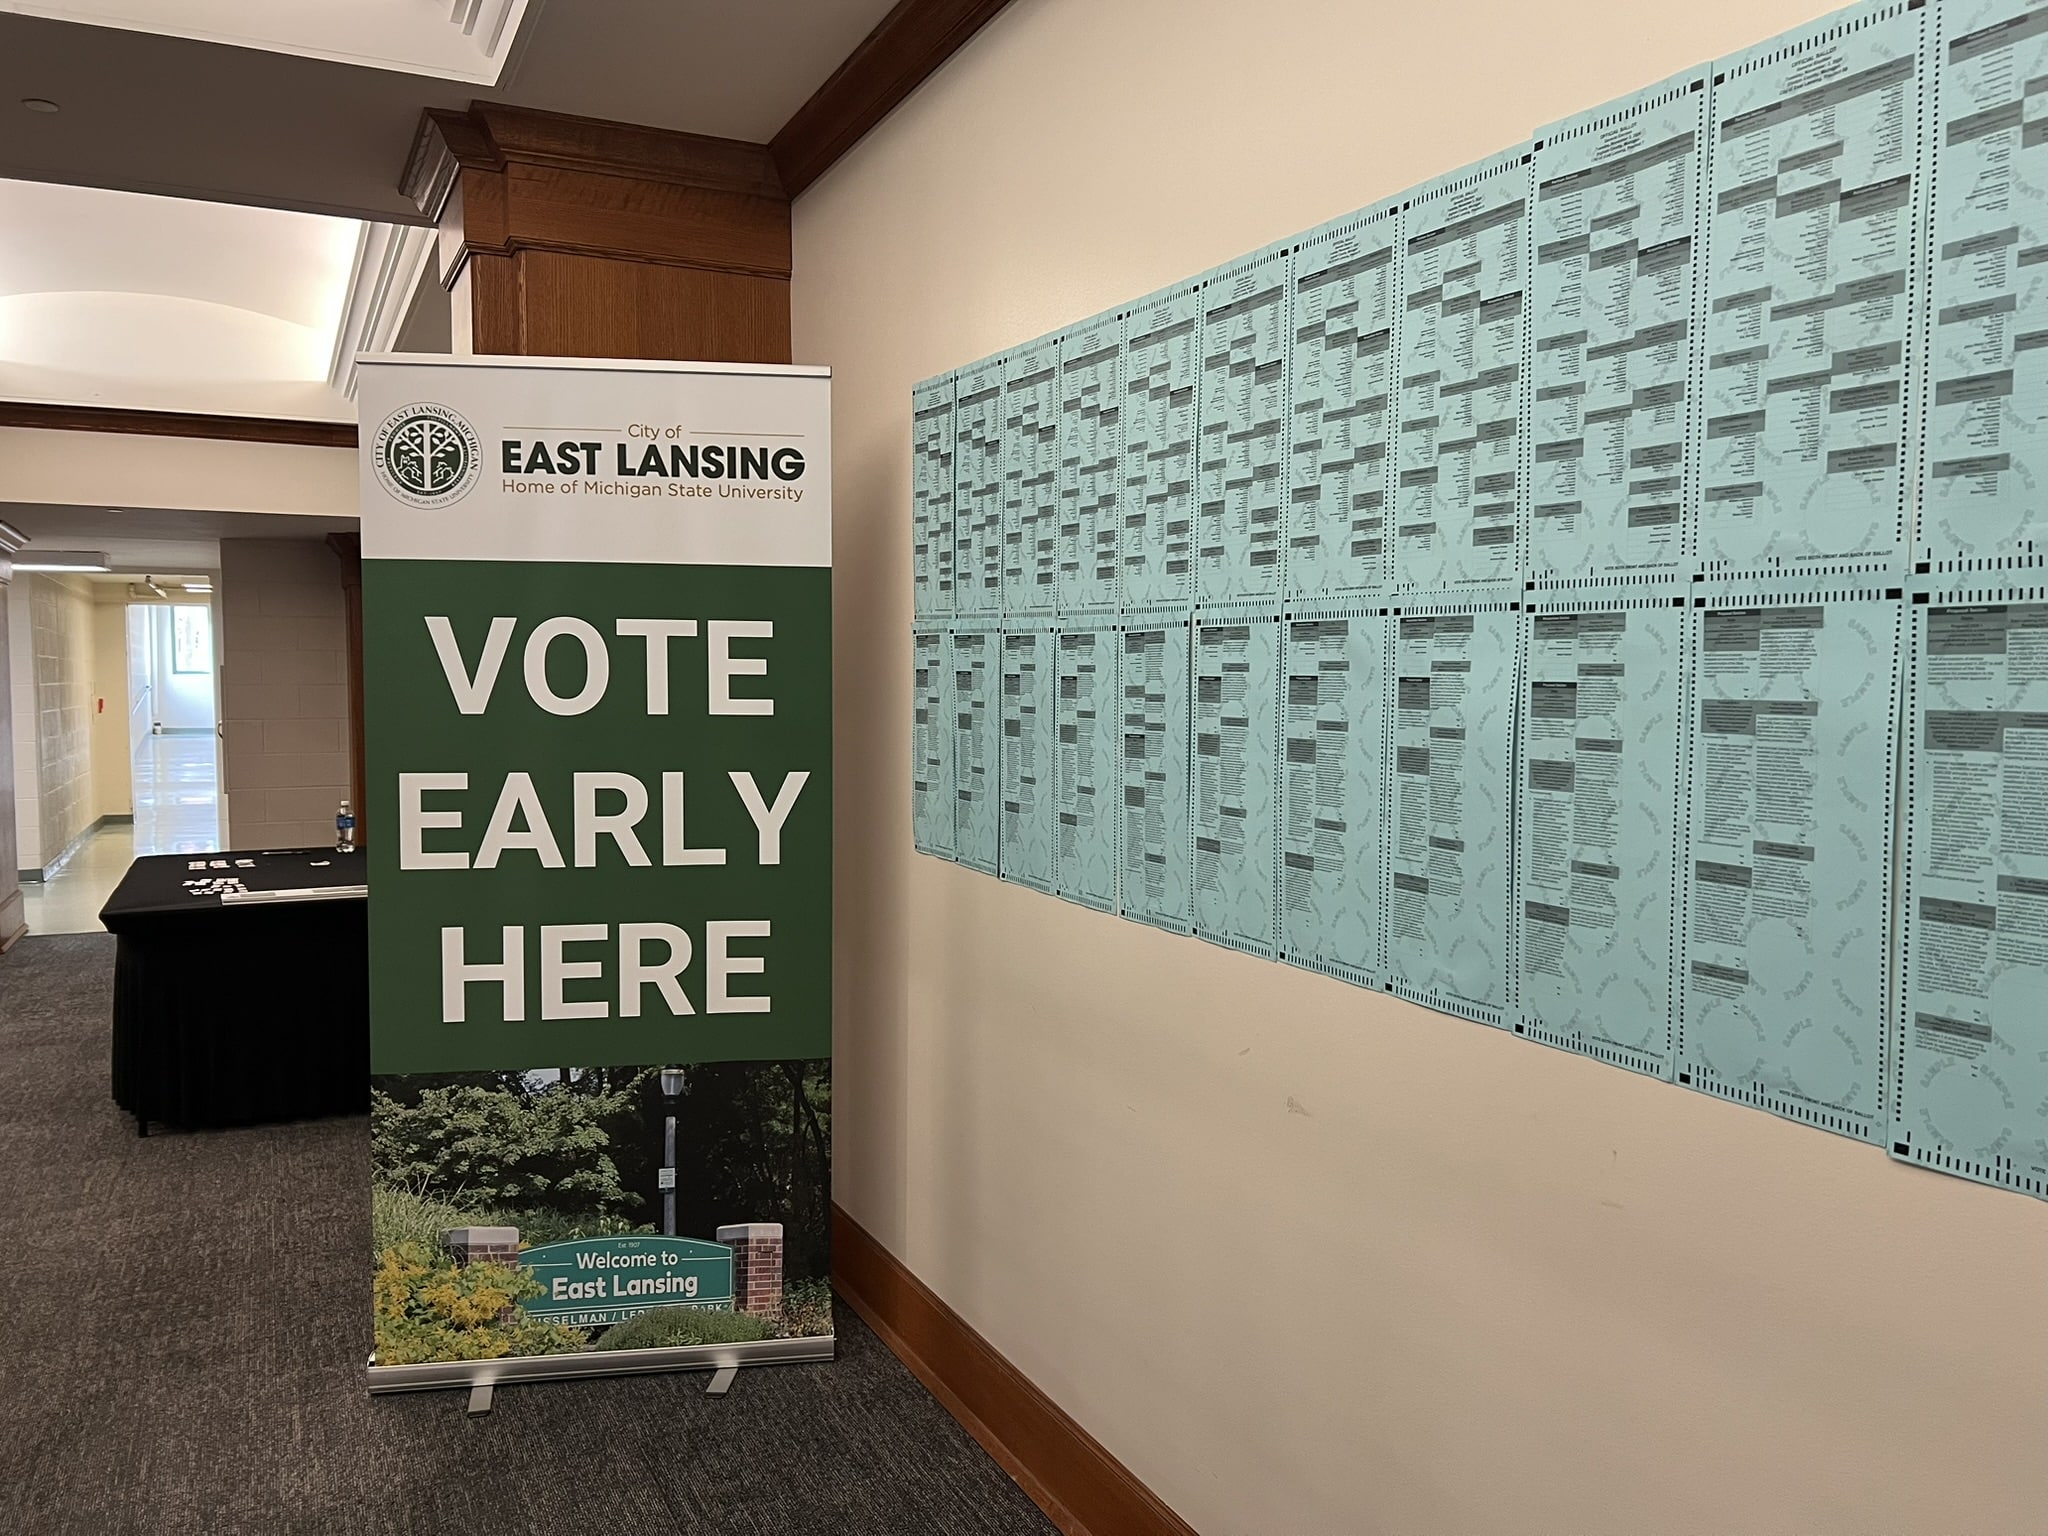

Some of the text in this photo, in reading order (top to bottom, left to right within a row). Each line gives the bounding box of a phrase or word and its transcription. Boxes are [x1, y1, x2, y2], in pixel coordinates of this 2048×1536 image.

[387, 410, 410, 429] EAST
[628, 424, 682, 440] City of
[379, 430, 389, 441] OF
[456, 420, 480, 470] MICHIGAN
[376, 444, 384, 468] CITY
[502, 440, 602, 475] EAST
[617, 443, 805, 481] LANSING
[502, 479, 804, 502] Home of Michigan State University
[1848, 618, 1878, 656] SAMPLE
[424, 616, 774, 716] VOTE
[399, 772, 811, 870] EARLY
[441, 920, 771, 1022] HERE
[1980, 1064, 2016, 1110] SAMPLE
[576, 1250, 678, 1270] Welcome to
[552, 1271, 698, 1300] East Lansing
[533, 1312, 608, 1326] USSELMAN
